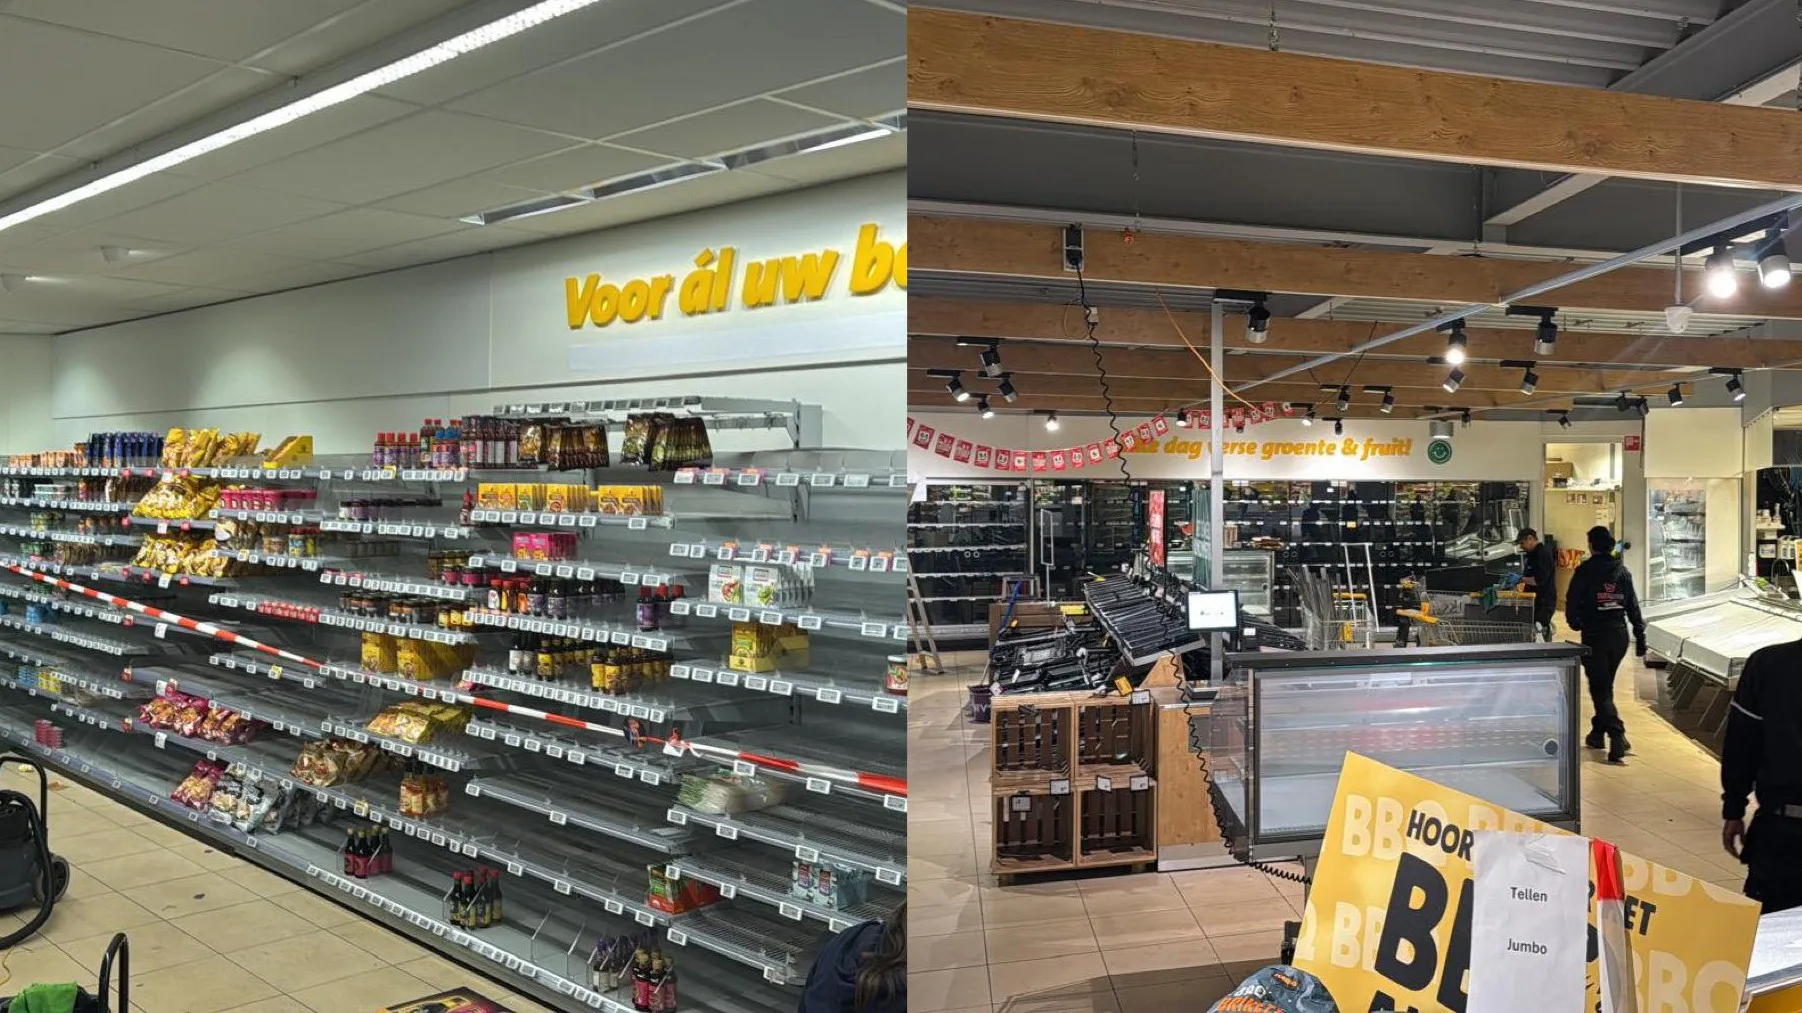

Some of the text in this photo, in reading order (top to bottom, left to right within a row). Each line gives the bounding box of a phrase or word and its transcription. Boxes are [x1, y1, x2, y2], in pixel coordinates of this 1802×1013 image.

[565, 273, 674, 329] Voor
[679, 247, 736, 316] ál
[742, 249, 840, 308] uw
[1164, 436, 1203, 459] dag
[1261, 439, 1337, 460] groente
[1341, 437, 1358, 456] &
[1360, 437, 1412, 461] fruit!
[1510, 887, 1548, 902] Tellen
[1507, 938, 1547, 954] Jumbo
